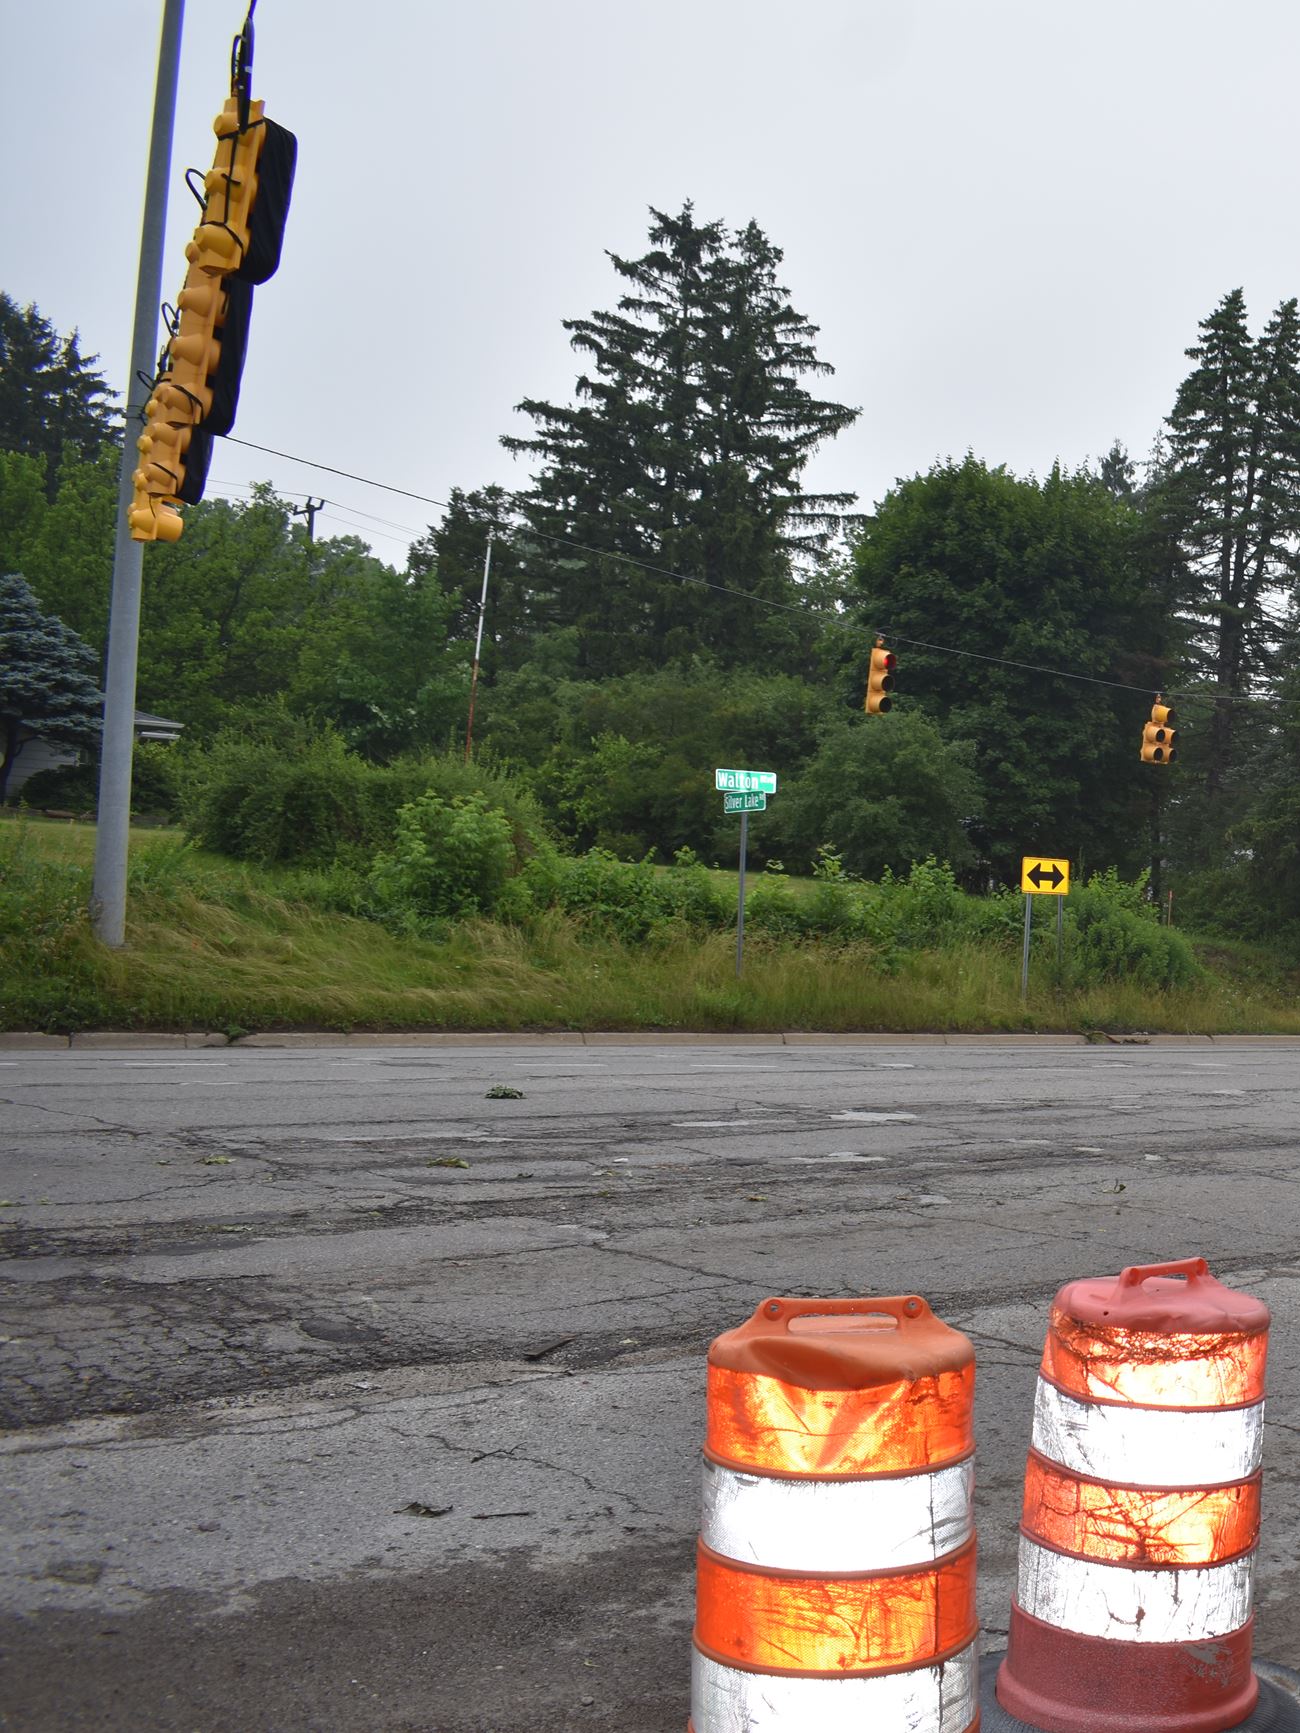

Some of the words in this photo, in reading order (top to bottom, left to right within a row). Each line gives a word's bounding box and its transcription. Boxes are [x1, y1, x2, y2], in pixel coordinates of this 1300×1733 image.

[718, 772, 758, 789] Walton
[725, 796, 742, 809] Silver
[745, 794, 758, 807] Lake
